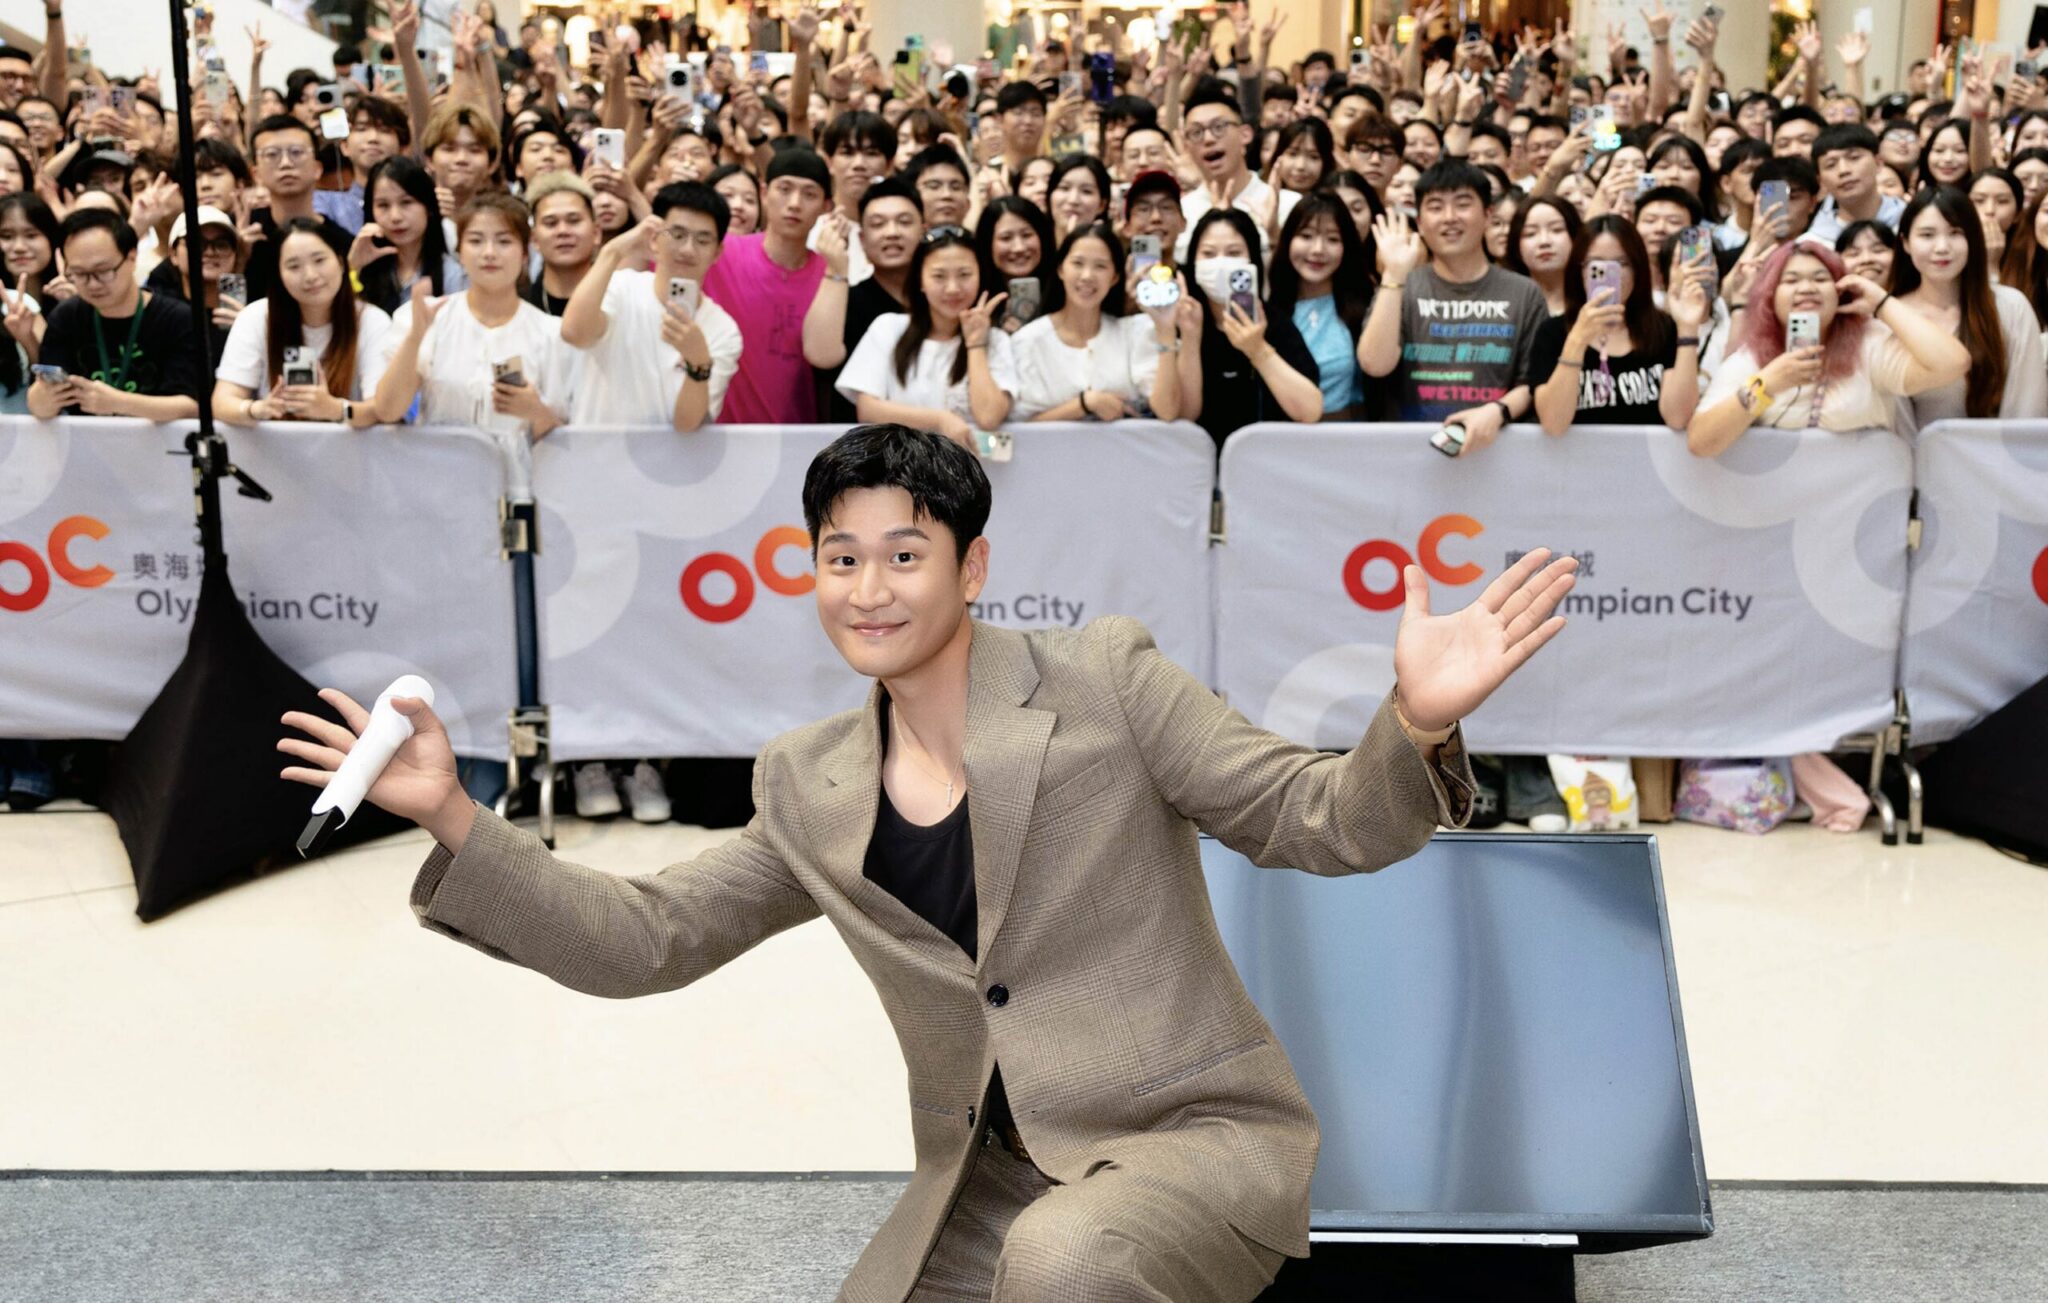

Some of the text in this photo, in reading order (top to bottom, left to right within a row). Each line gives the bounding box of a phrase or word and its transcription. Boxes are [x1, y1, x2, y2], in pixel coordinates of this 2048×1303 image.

[136, 588, 378, 627] Olyian City
[1013, 593, 1085, 627] City
[1681, 587, 1753, 621] City
